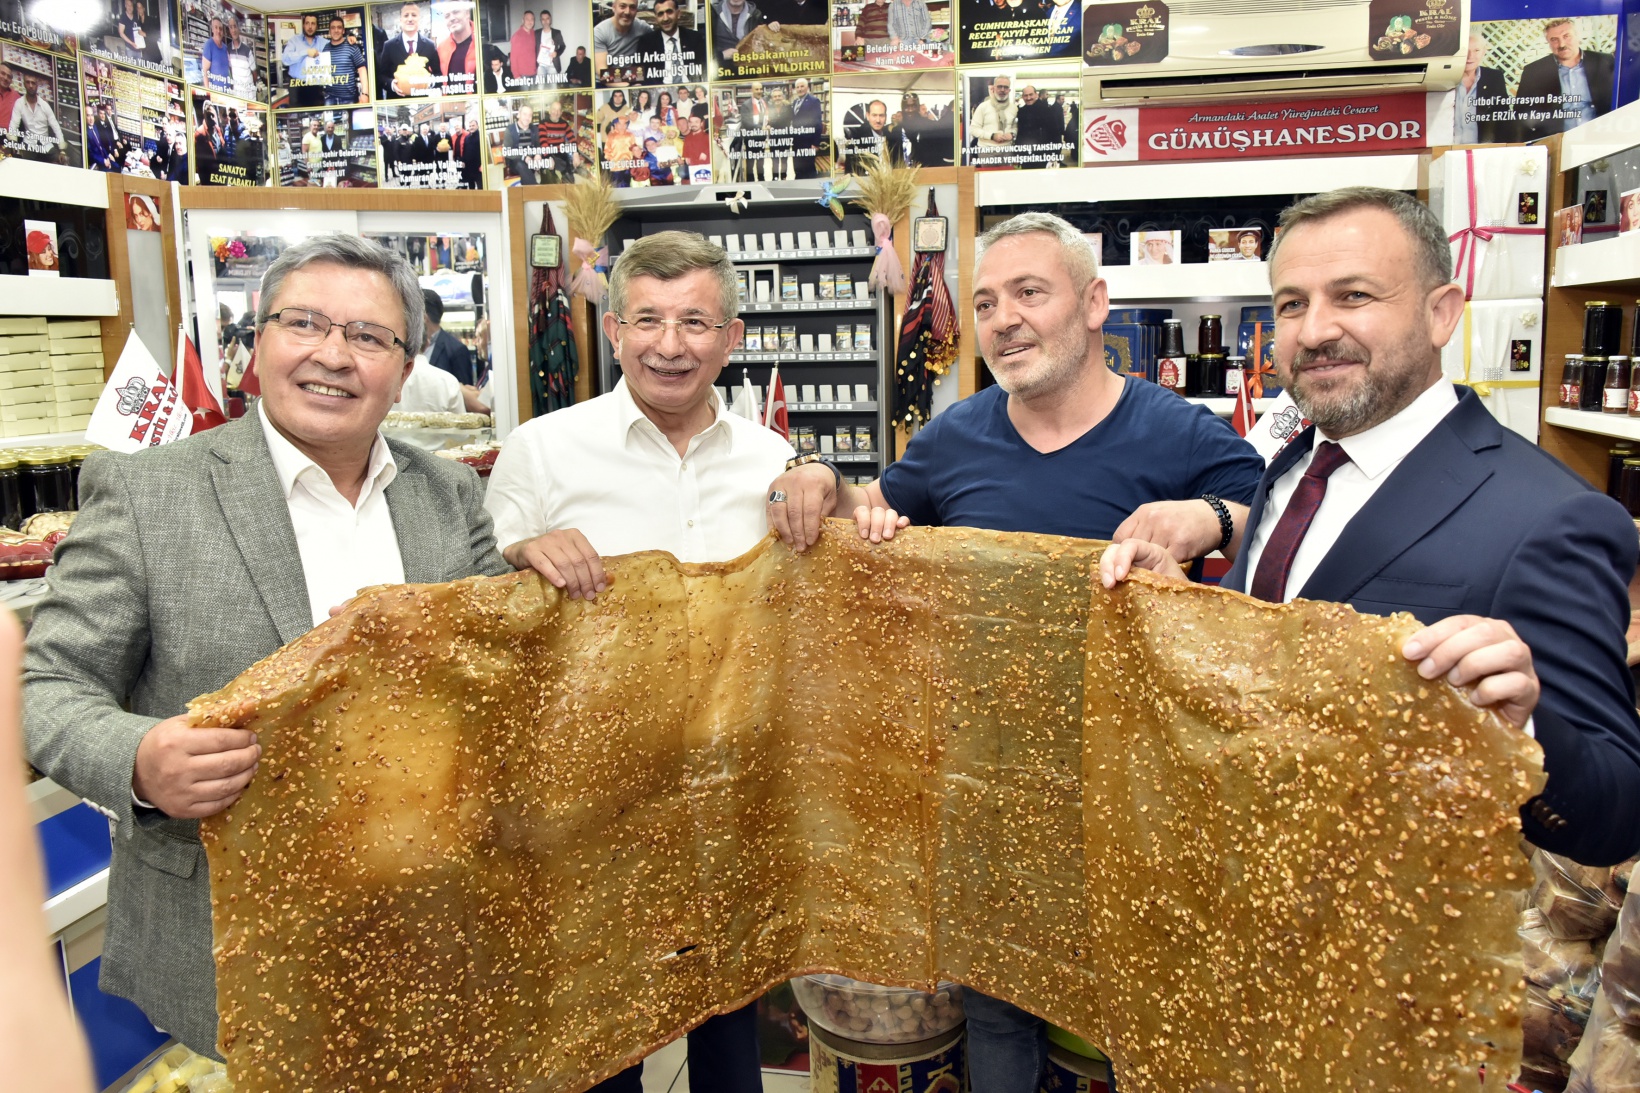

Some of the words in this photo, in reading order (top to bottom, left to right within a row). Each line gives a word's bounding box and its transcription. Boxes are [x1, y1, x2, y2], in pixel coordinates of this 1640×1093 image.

[974, 18, 1068, 31] CUMHURBAŞKANIMIZ
[12, 21, 30, 37] Erol
[32, 27, 60, 45] BUDAN
[968, 32, 997, 40] RECEP
[999, 28, 1029, 38] TAYYİP
[1030, 26, 1074, 36] ERDOĞAN
[866, 44, 897, 54] Belediye
[899, 42, 942, 53] Başkanımız
[971, 39, 1013, 49] BELEDİYE
[1016, 36, 1071, 48] BAŞKANIMIZ
[91, 46, 112, 60] Sanatçı
[114, 52, 136, 66] Mustafa
[606, 53, 641, 67] Değerli
[643, 51, 695, 63] Arkadaşım
[733, 49, 809, 64] Başbakanımız
[876, 57, 894, 66] Naim
[896, 55, 915, 66] AĞAÇ
[646, 67, 668, 78] Akın
[671, 63, 702, 76] ÜSTÜN
[718, 68, 734, 77] Sn.
[738, 64, 769, 75] Binali
[772, 61, 825, 73] YILDIRIM
[505, 76, 534, 87] Sanatçı
[535, 75, 545, 84] Ali
[547, 73, 568, 83] KINIK
[1468, 96, 1495, 108] Futbol
[1496, 95, 1545, 108] Federasyon
[1547, 94, 1582, 106] Başkanı
[1188, 112, 1245, 123] Armandaki
[1247, 110, 1279, 121] Asalet
[1281, 106, 1340, 121] Yüreğindeki
[1342, 104, 1379, 116] Cesaret
[1465, 113, 1490, 124] Şenez
[1493, 110, 1516, 121] ERZİK
[1530, 111, 1550, 122] Kaya
[1552, 110, 1582, 119] Abimiz
[741, 128, 768, 137] Ocakları
[770, 127, 788, 136] Genel
[789, 126, 815, 135] Başkanı
[1147, 120, 1421, 152] GÜMÜŞHANESPOR
[4, 139, 26, 151] Selçuk
[502, 144, 558, 156] Gümüşhanenin
[560, 143, 577, 153] Gülü
[748, 140, 766, 149] Olcay
[767, 138, 794, 146] KILAVUZ
[995, 144, 1032, 154] OYUNCUSU
[338, 149, 367, 158] Belediyesi
[728, 151, 740, 160] MHP
[748, 150, 774, 160] Başkanı
[774, 149, 796, 158] Nedim
[796, 148, 816, 157] AYDIN
[1003, 154, 1064, 164] YENİŞEHİRLİOĞLU
[528, 156, 552, 169] HAMDİ
[218, 163, 246, 177] SANATÇI
[210, 173, 227, 184] ESAT
[227, 176, 256, 187] KABAKLI
[163, 406, 173, 416] &
